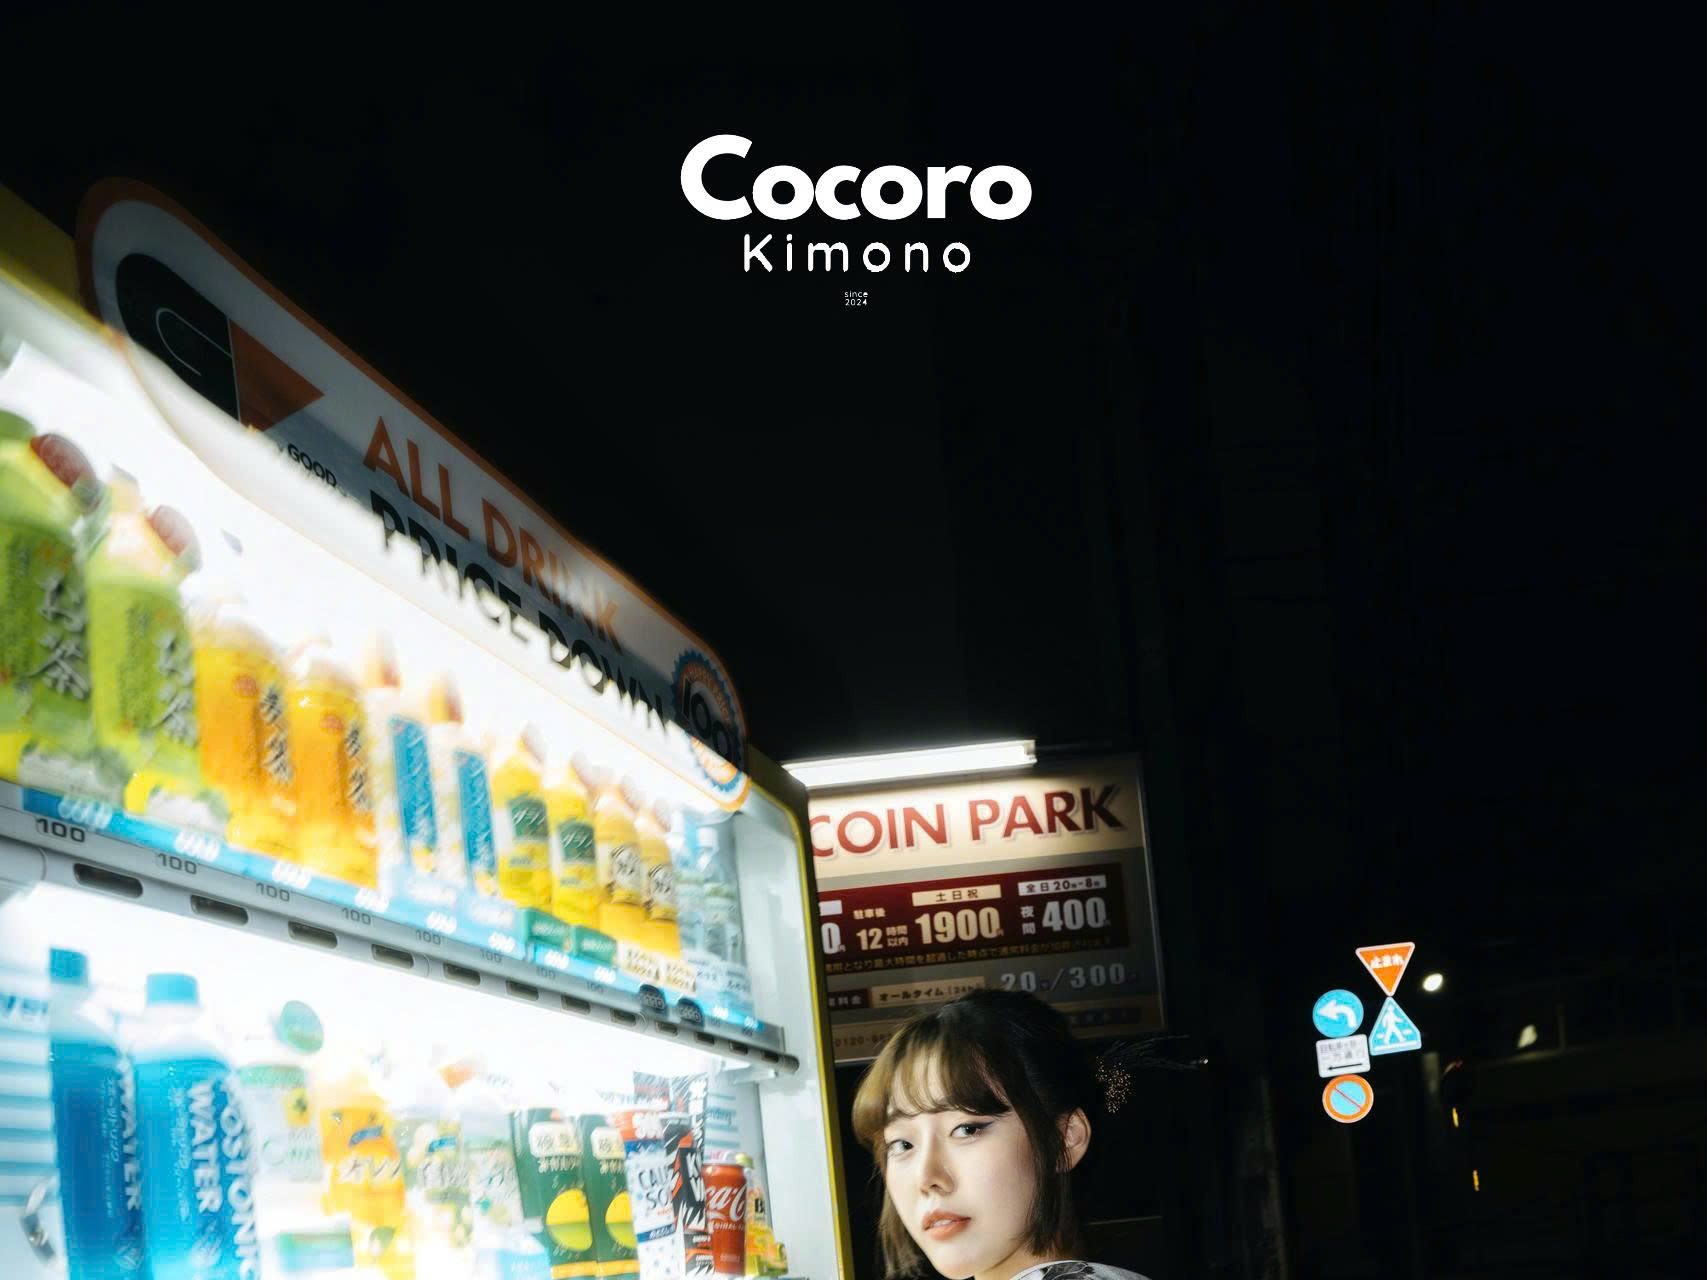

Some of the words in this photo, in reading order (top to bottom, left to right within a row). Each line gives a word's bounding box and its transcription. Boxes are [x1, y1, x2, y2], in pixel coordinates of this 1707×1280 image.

[287, 443, 337, 488] GOOD
[363, 416, 470, 541] ALL
[36, 817, 85, 843] 100
[808, 803, 947, 858] COIN
[968, 784, 1126, 842] PARK
[157, 853, 197, 875] 100
[256, 881, 291, 902] 100
[341, 907, 372, 926] 100
[1042, 897, 1107, 932] 400
[856, 927, 883, 951] 12
[187, 1079, 223, 1213] WATER
